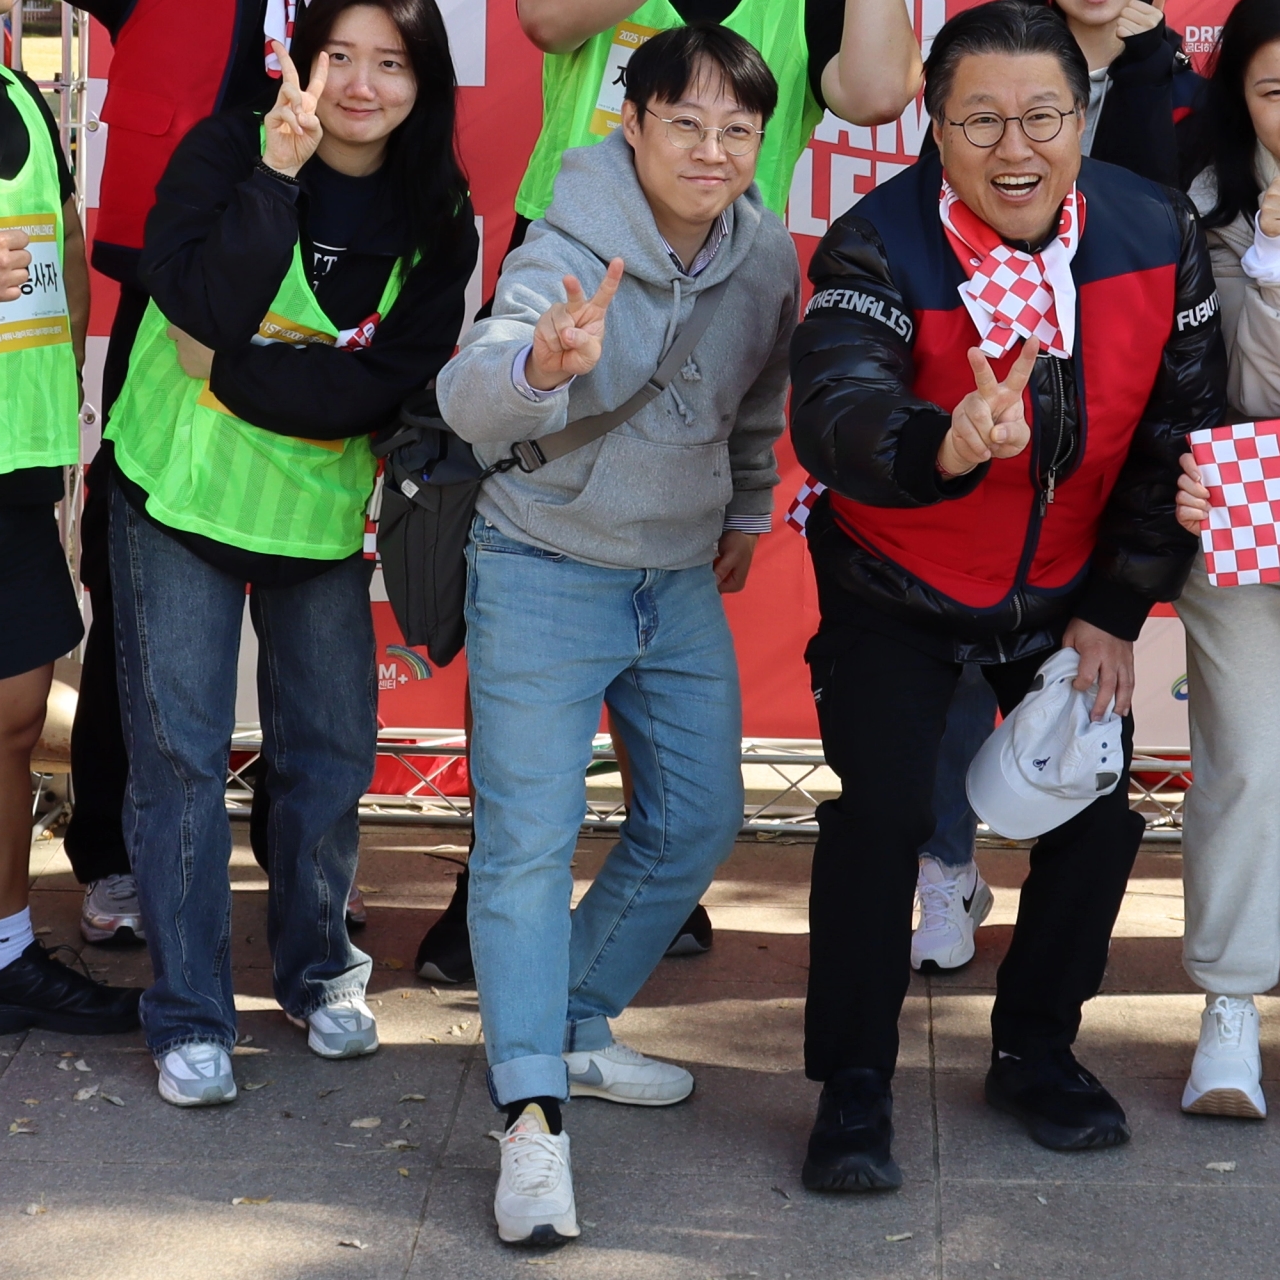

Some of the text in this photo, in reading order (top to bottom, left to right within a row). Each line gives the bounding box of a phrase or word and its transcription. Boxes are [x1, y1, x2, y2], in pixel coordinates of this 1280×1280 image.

[619, 29, 639, 45] 2025
[1185, 42, 1221, 54] 꿈더하
[264, 321, 281, 334] 1ST
